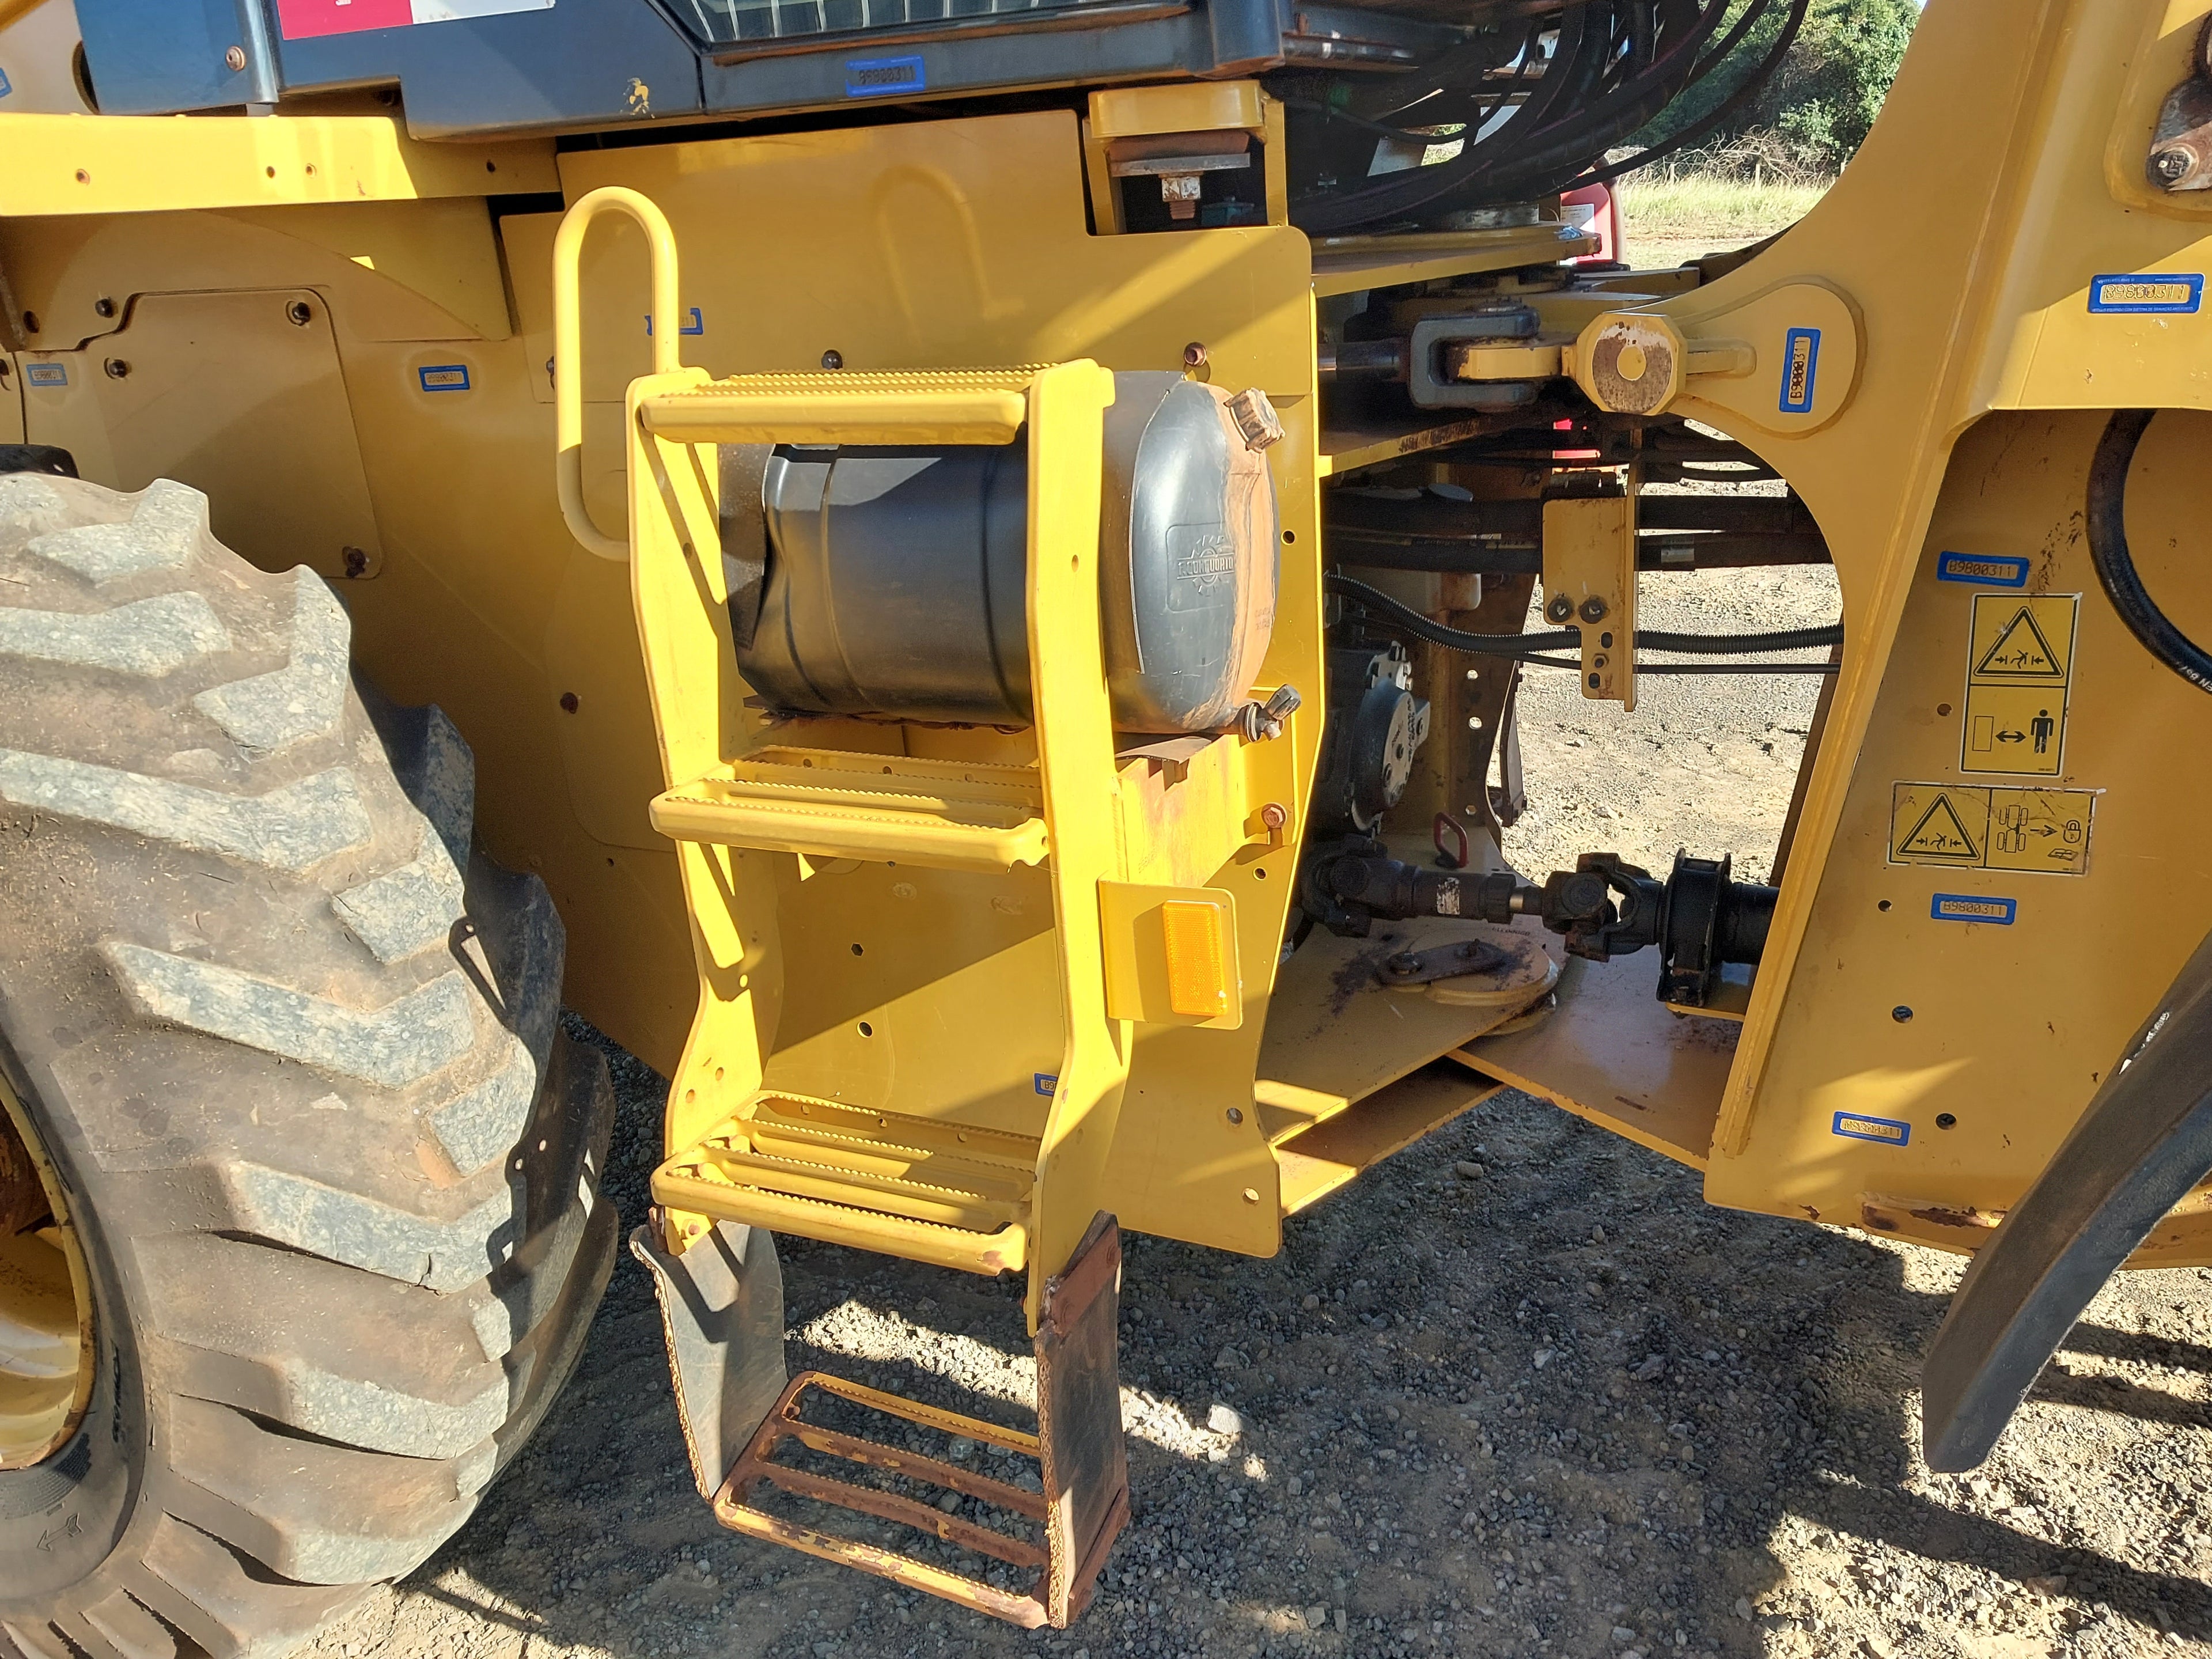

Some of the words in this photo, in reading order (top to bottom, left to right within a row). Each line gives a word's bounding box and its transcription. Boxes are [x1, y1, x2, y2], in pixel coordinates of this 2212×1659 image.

[2104, 285, 2186, 300] B9800311
[1949, 560, 2011, 577] B9800311
[1943, 901, 2002, 916] B9800311
